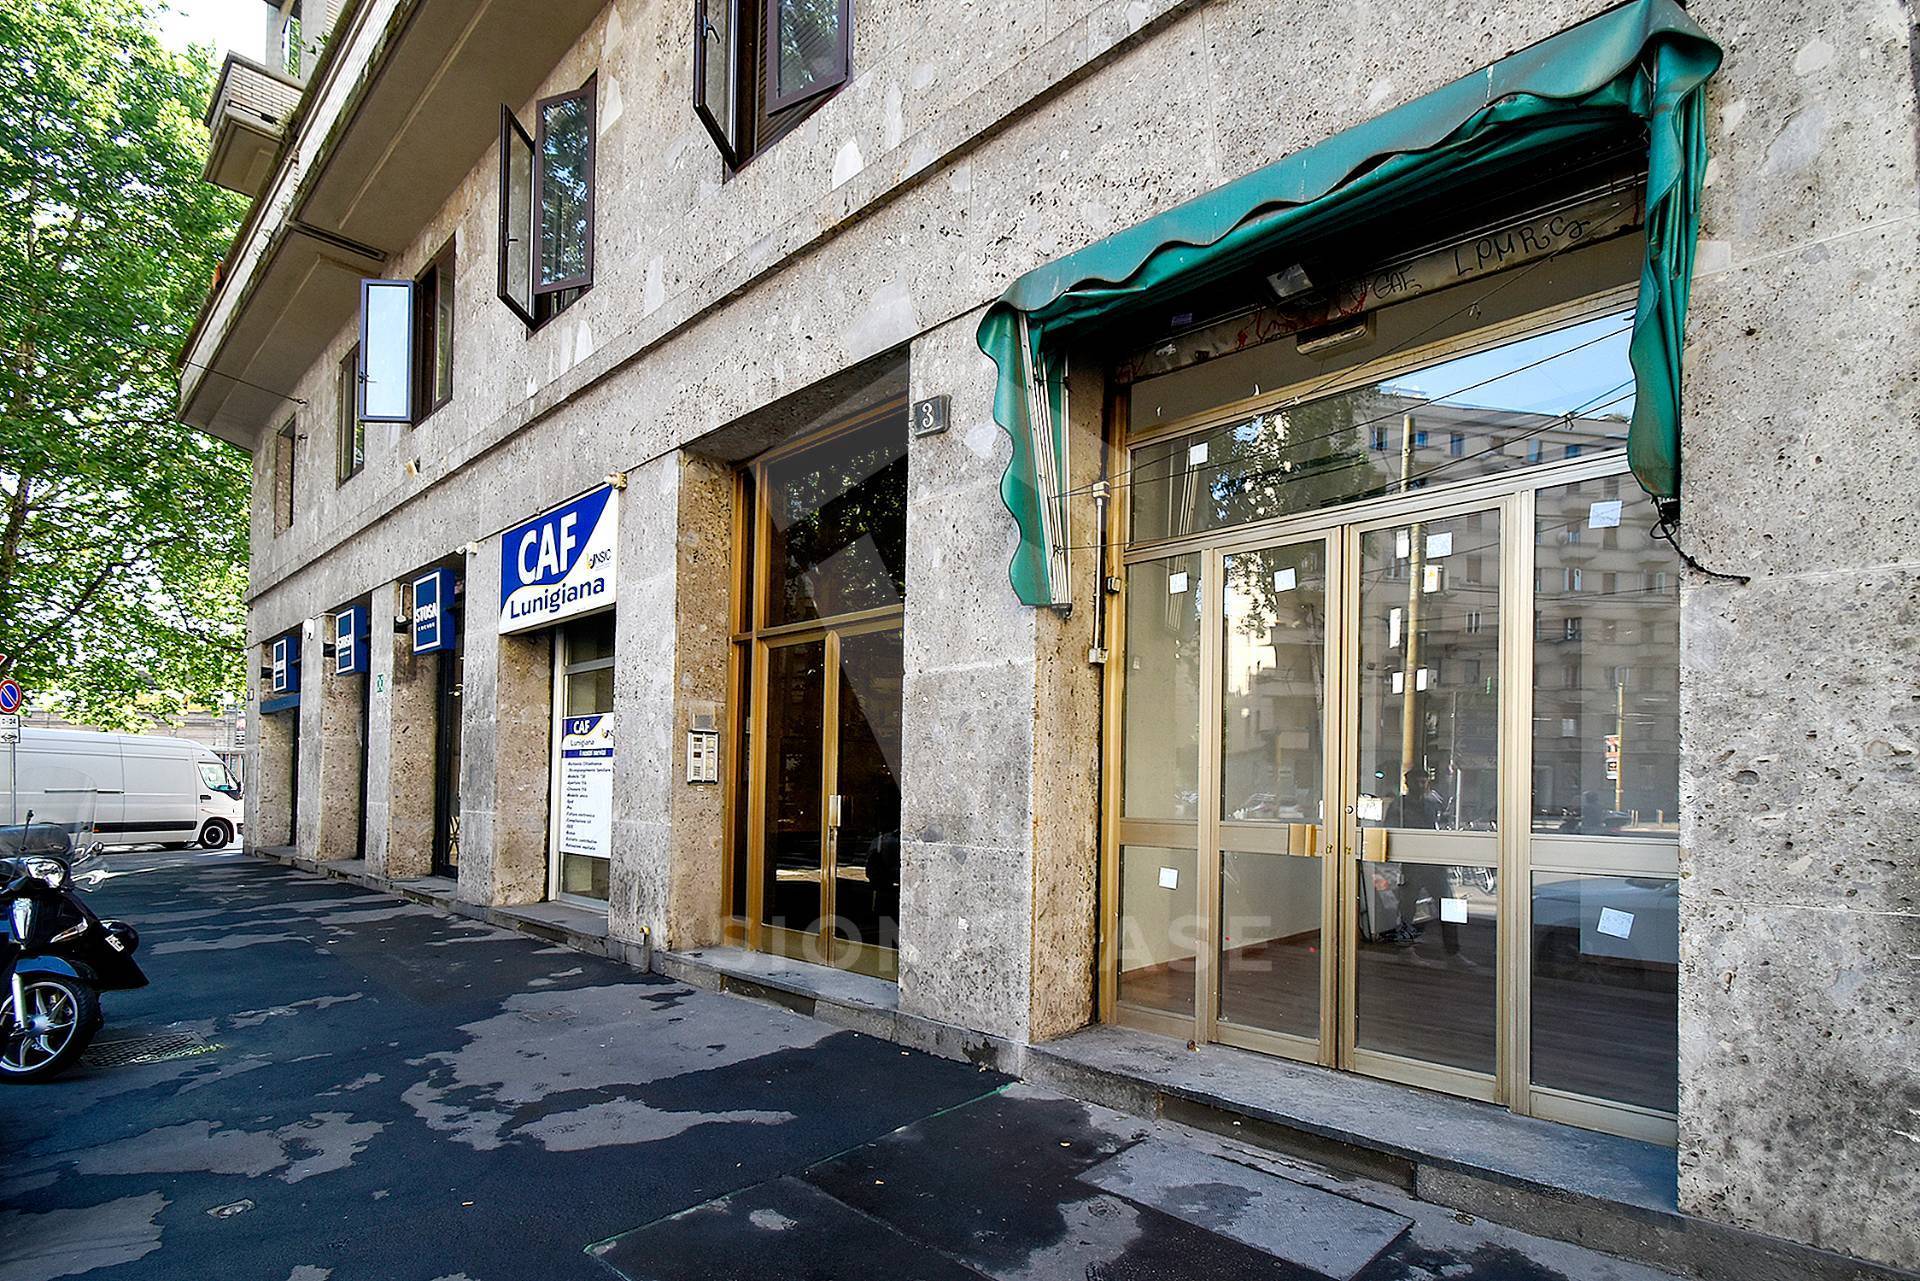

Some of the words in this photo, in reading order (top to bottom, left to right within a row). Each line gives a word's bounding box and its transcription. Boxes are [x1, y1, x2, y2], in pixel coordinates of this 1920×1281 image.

[921, 402, 934, 428] 3
[517, 510, 578, 586] CAF
[510, 576, 605, 620] Lunigiana
[573, 720, 590, 734] CAF
